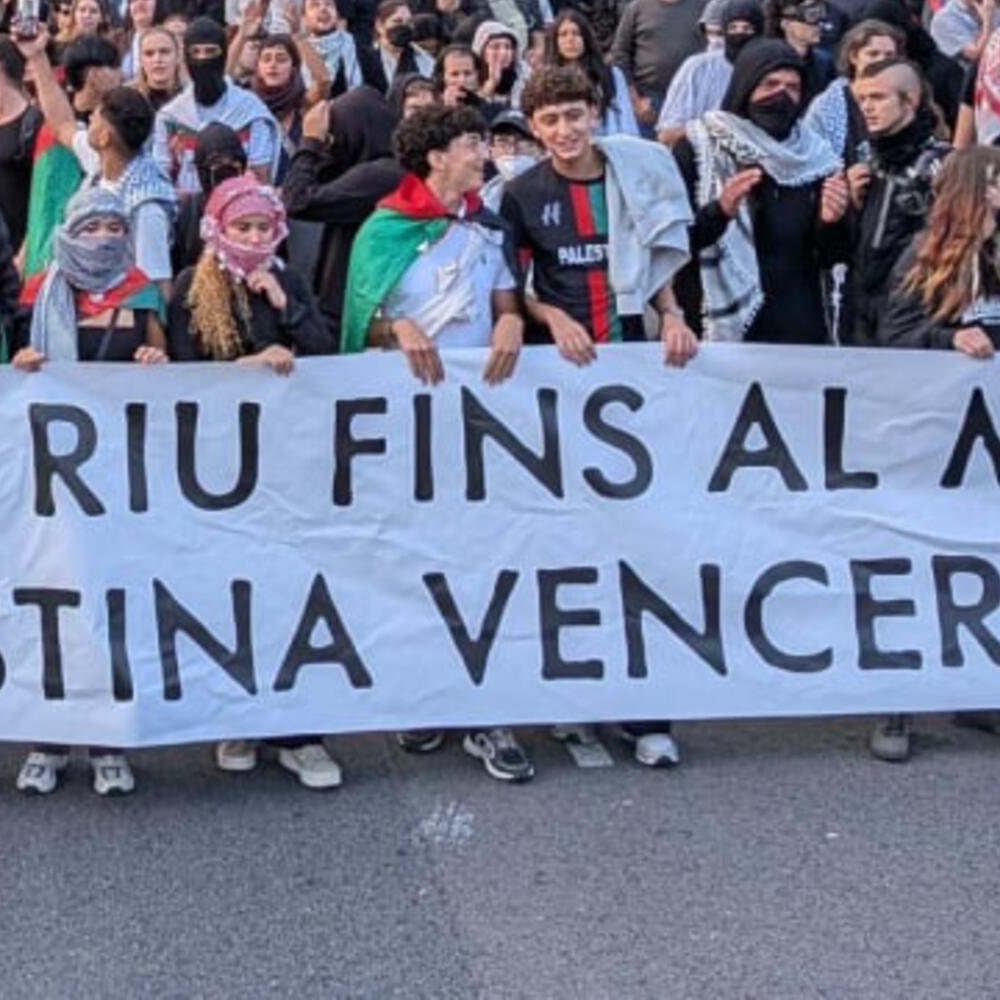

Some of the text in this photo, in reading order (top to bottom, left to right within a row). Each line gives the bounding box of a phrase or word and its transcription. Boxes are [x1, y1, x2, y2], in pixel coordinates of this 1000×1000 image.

[29, 401, 261, 517] RIU
[332, 385, 654, 507] FINS
[707, 381, 879, 493] AL
